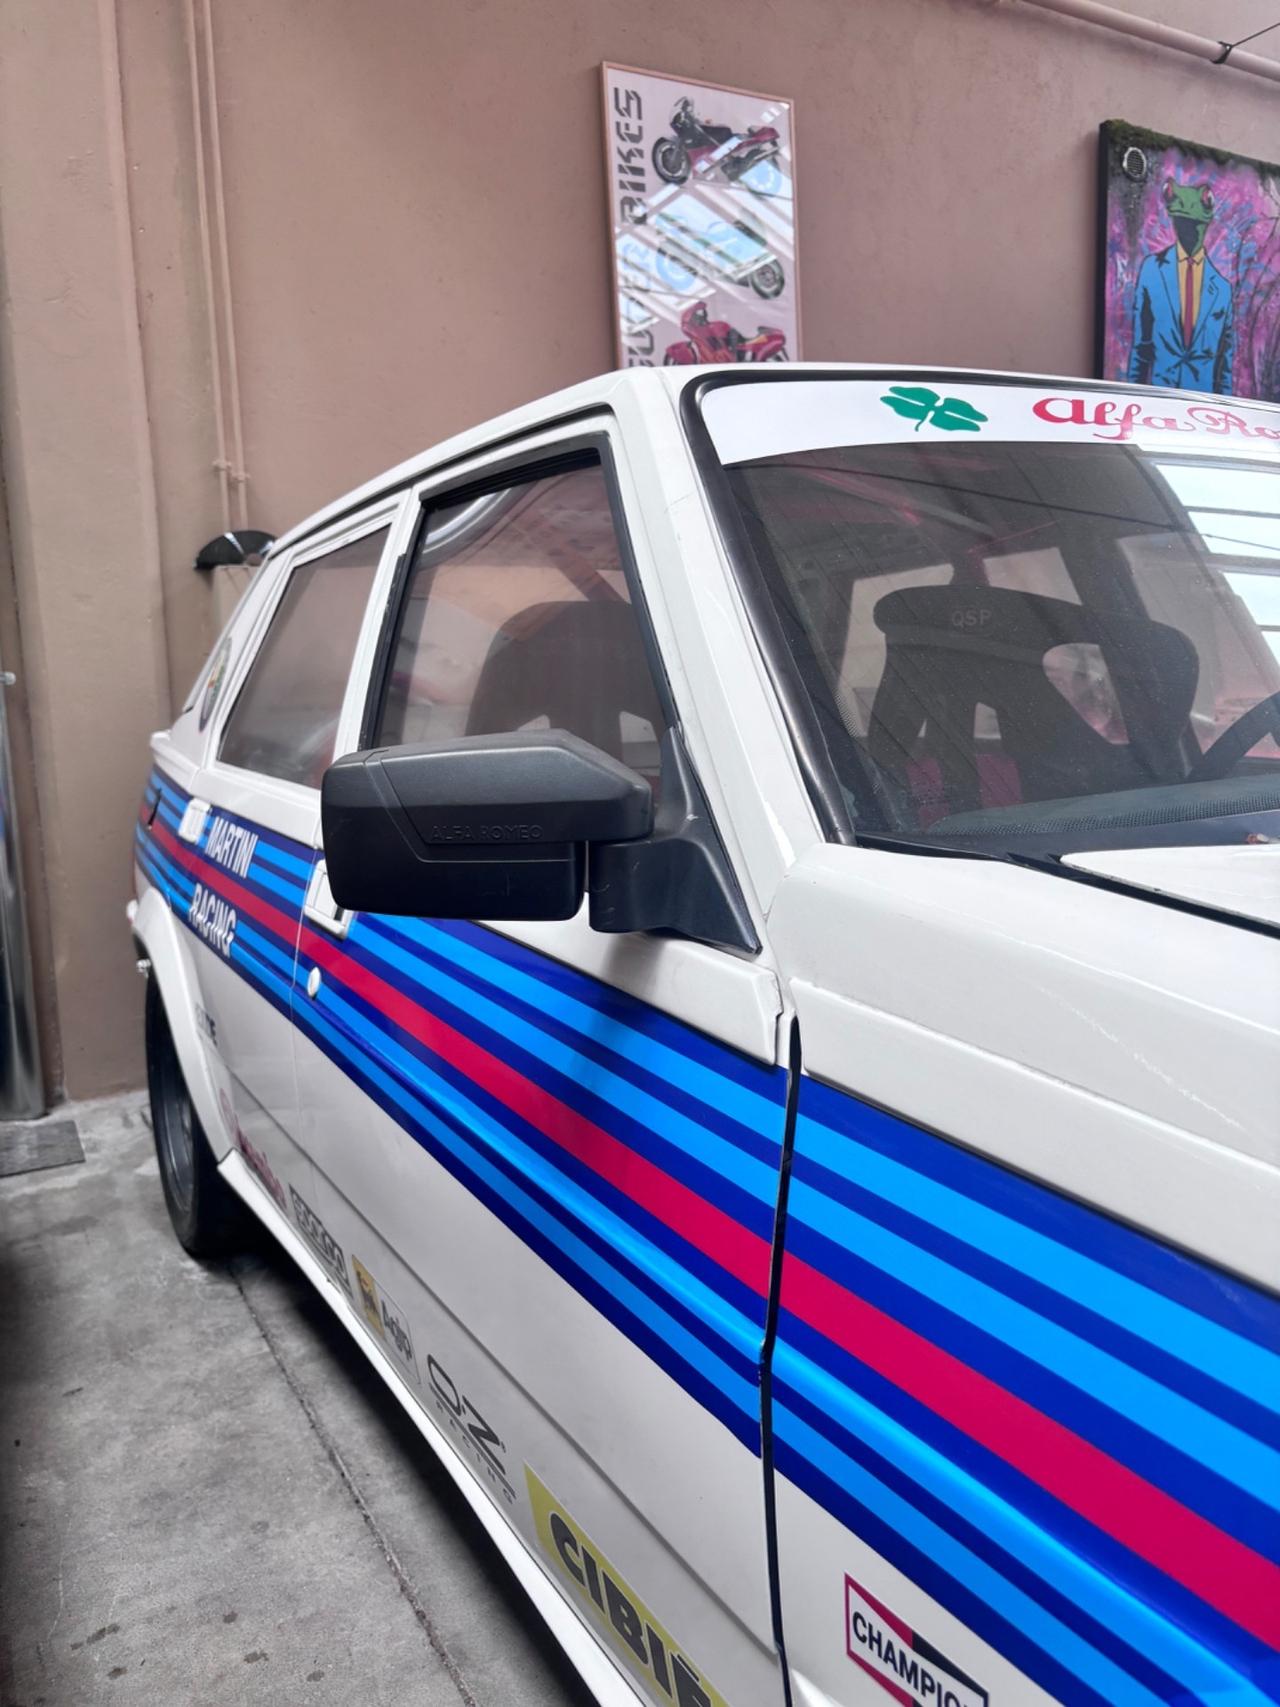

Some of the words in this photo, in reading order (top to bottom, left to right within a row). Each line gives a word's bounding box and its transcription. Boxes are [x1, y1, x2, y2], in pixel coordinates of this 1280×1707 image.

[1032, 397, 1195, 440] Alfa
[951, 608, 992, 628] QSP
[204, 816, 259, 879] MARTINI
[432, 824, 474, 840] ALFA
[480, 824, 544, 840] ROMEO
[188, 882, 237, 958] RACING
